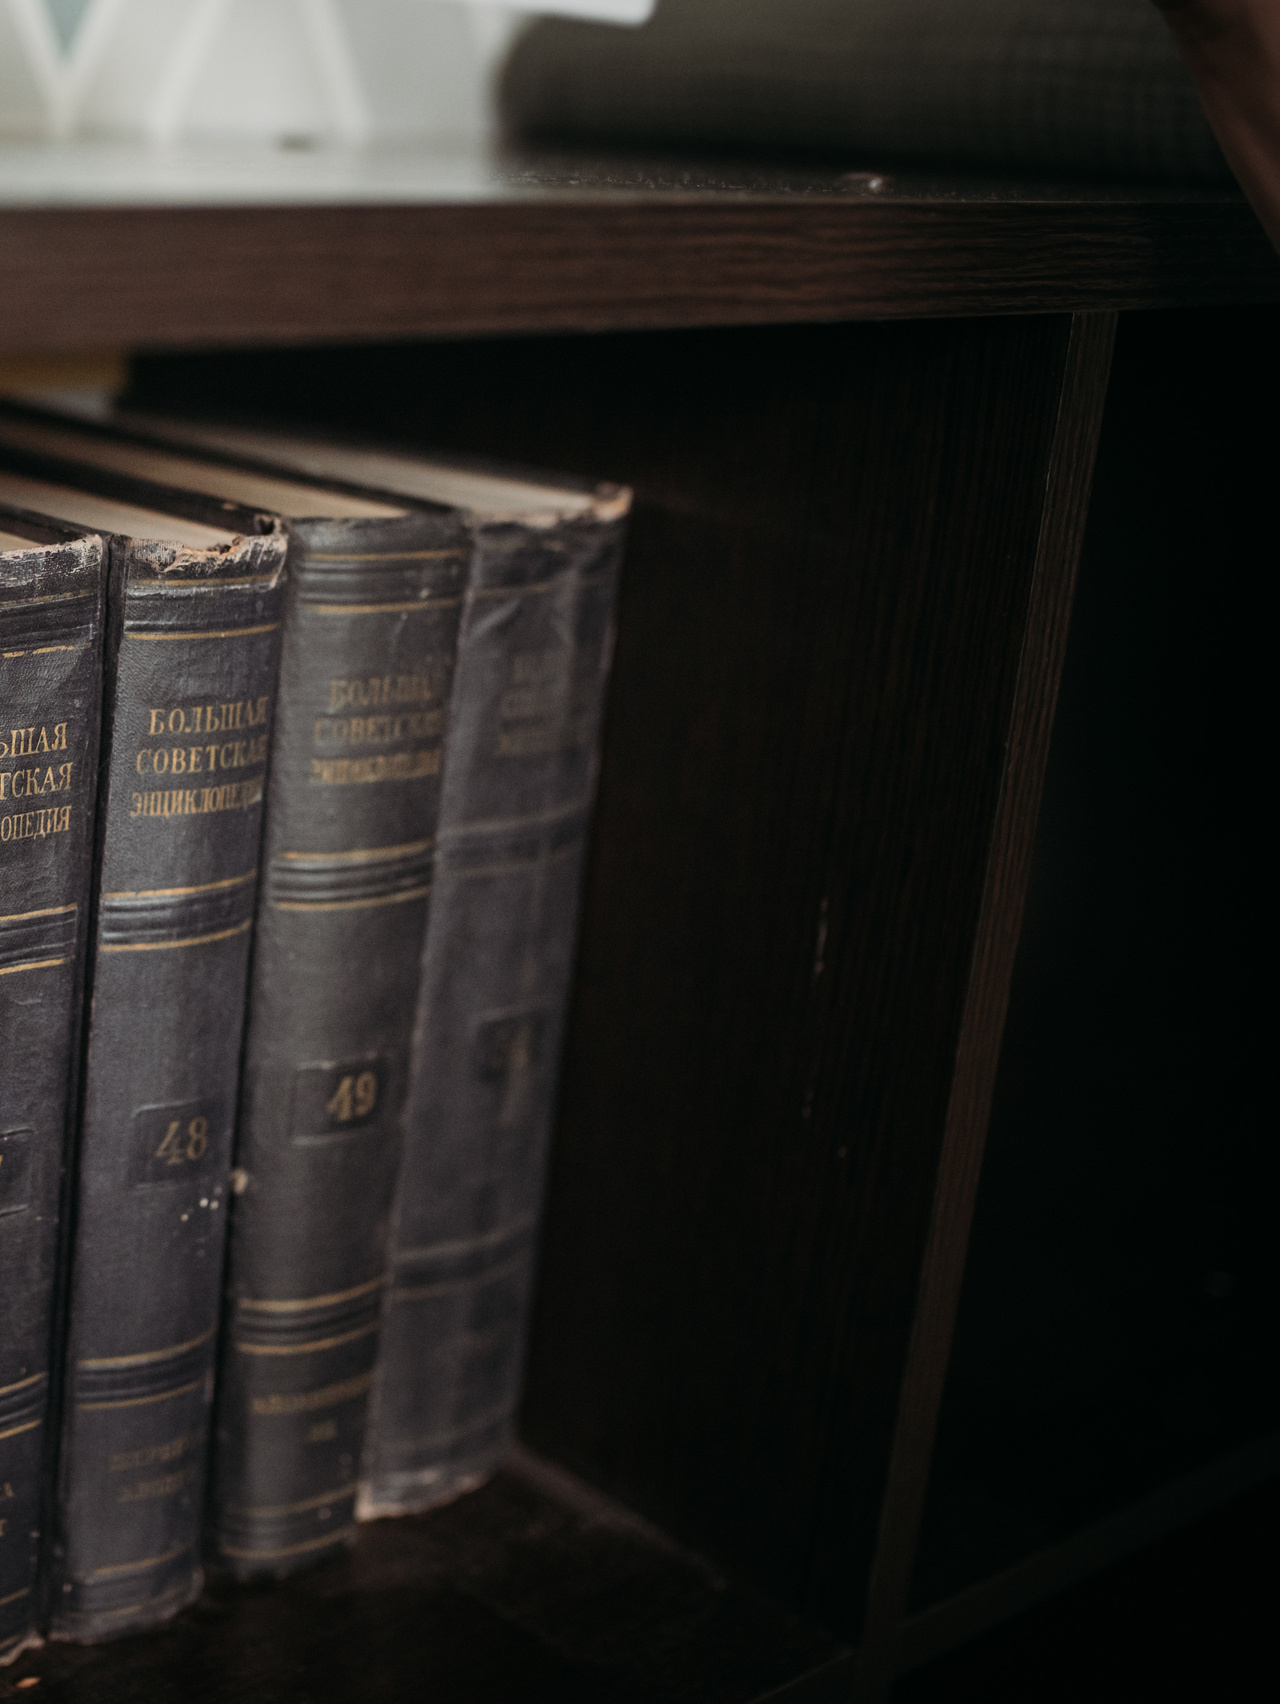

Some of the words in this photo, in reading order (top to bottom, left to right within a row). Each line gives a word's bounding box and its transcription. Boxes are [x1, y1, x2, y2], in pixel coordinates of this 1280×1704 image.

[148, 697, 269, 736] БОЛЬШАЯ
[326, 1071, 378, 1121] 49
[155, 1115, 209, 1165] 48
